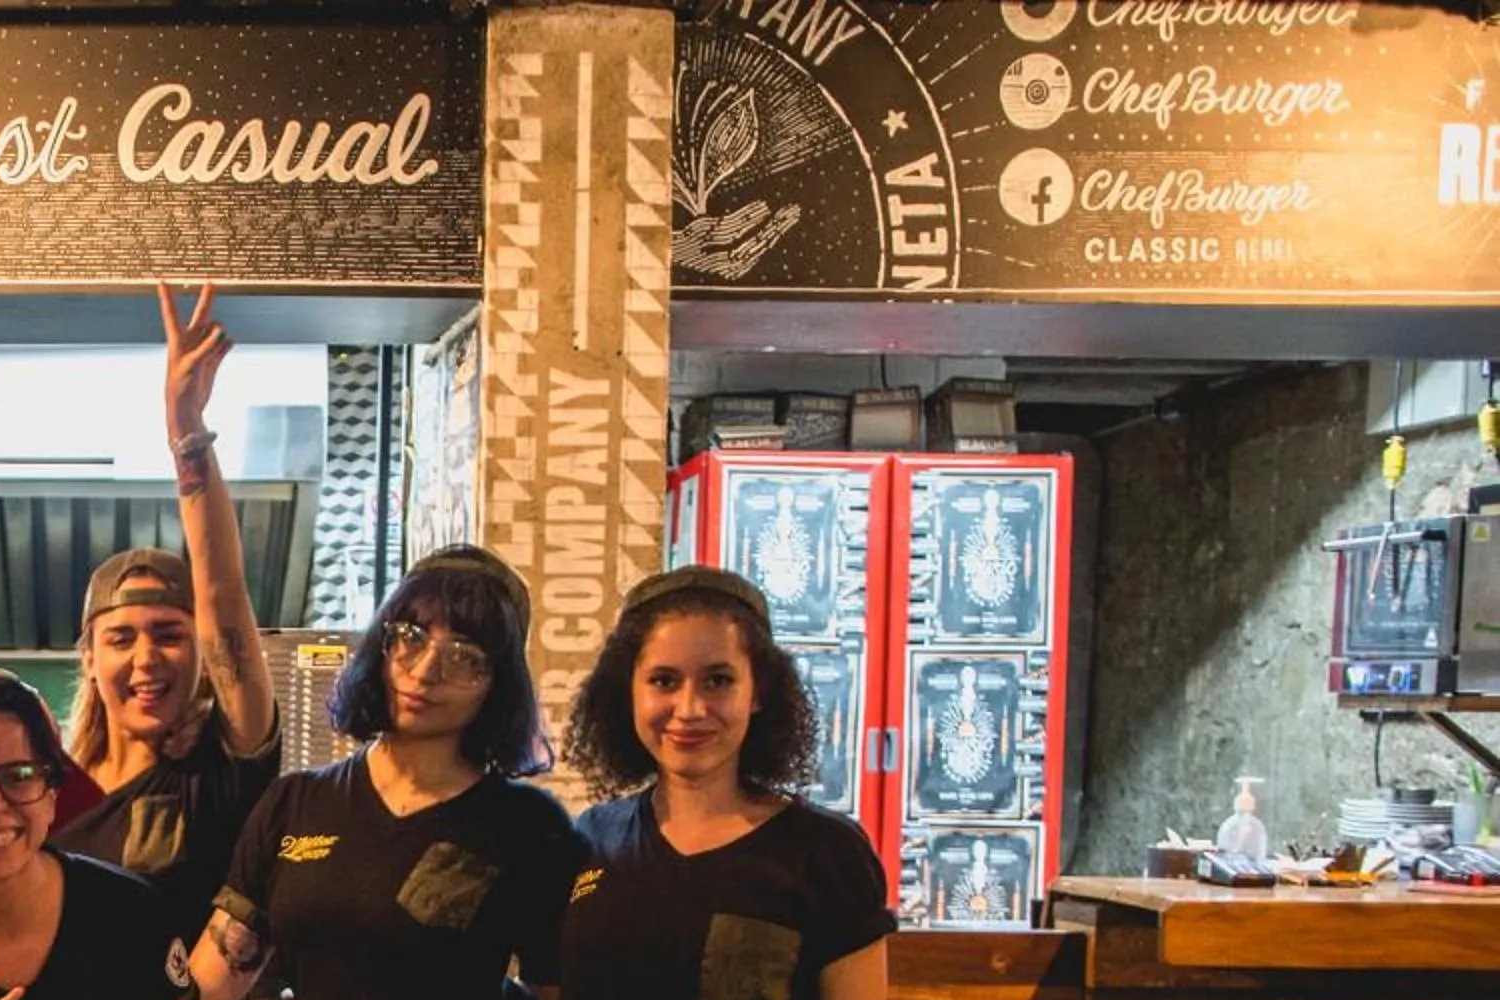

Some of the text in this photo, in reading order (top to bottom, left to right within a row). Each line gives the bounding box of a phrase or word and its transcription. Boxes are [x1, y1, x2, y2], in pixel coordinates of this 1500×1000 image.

[117, 83, 440, 186] Casual
[1084, 237, 1221, 263] CLASSIC
[540, 368, 611, 653] COMPANY
